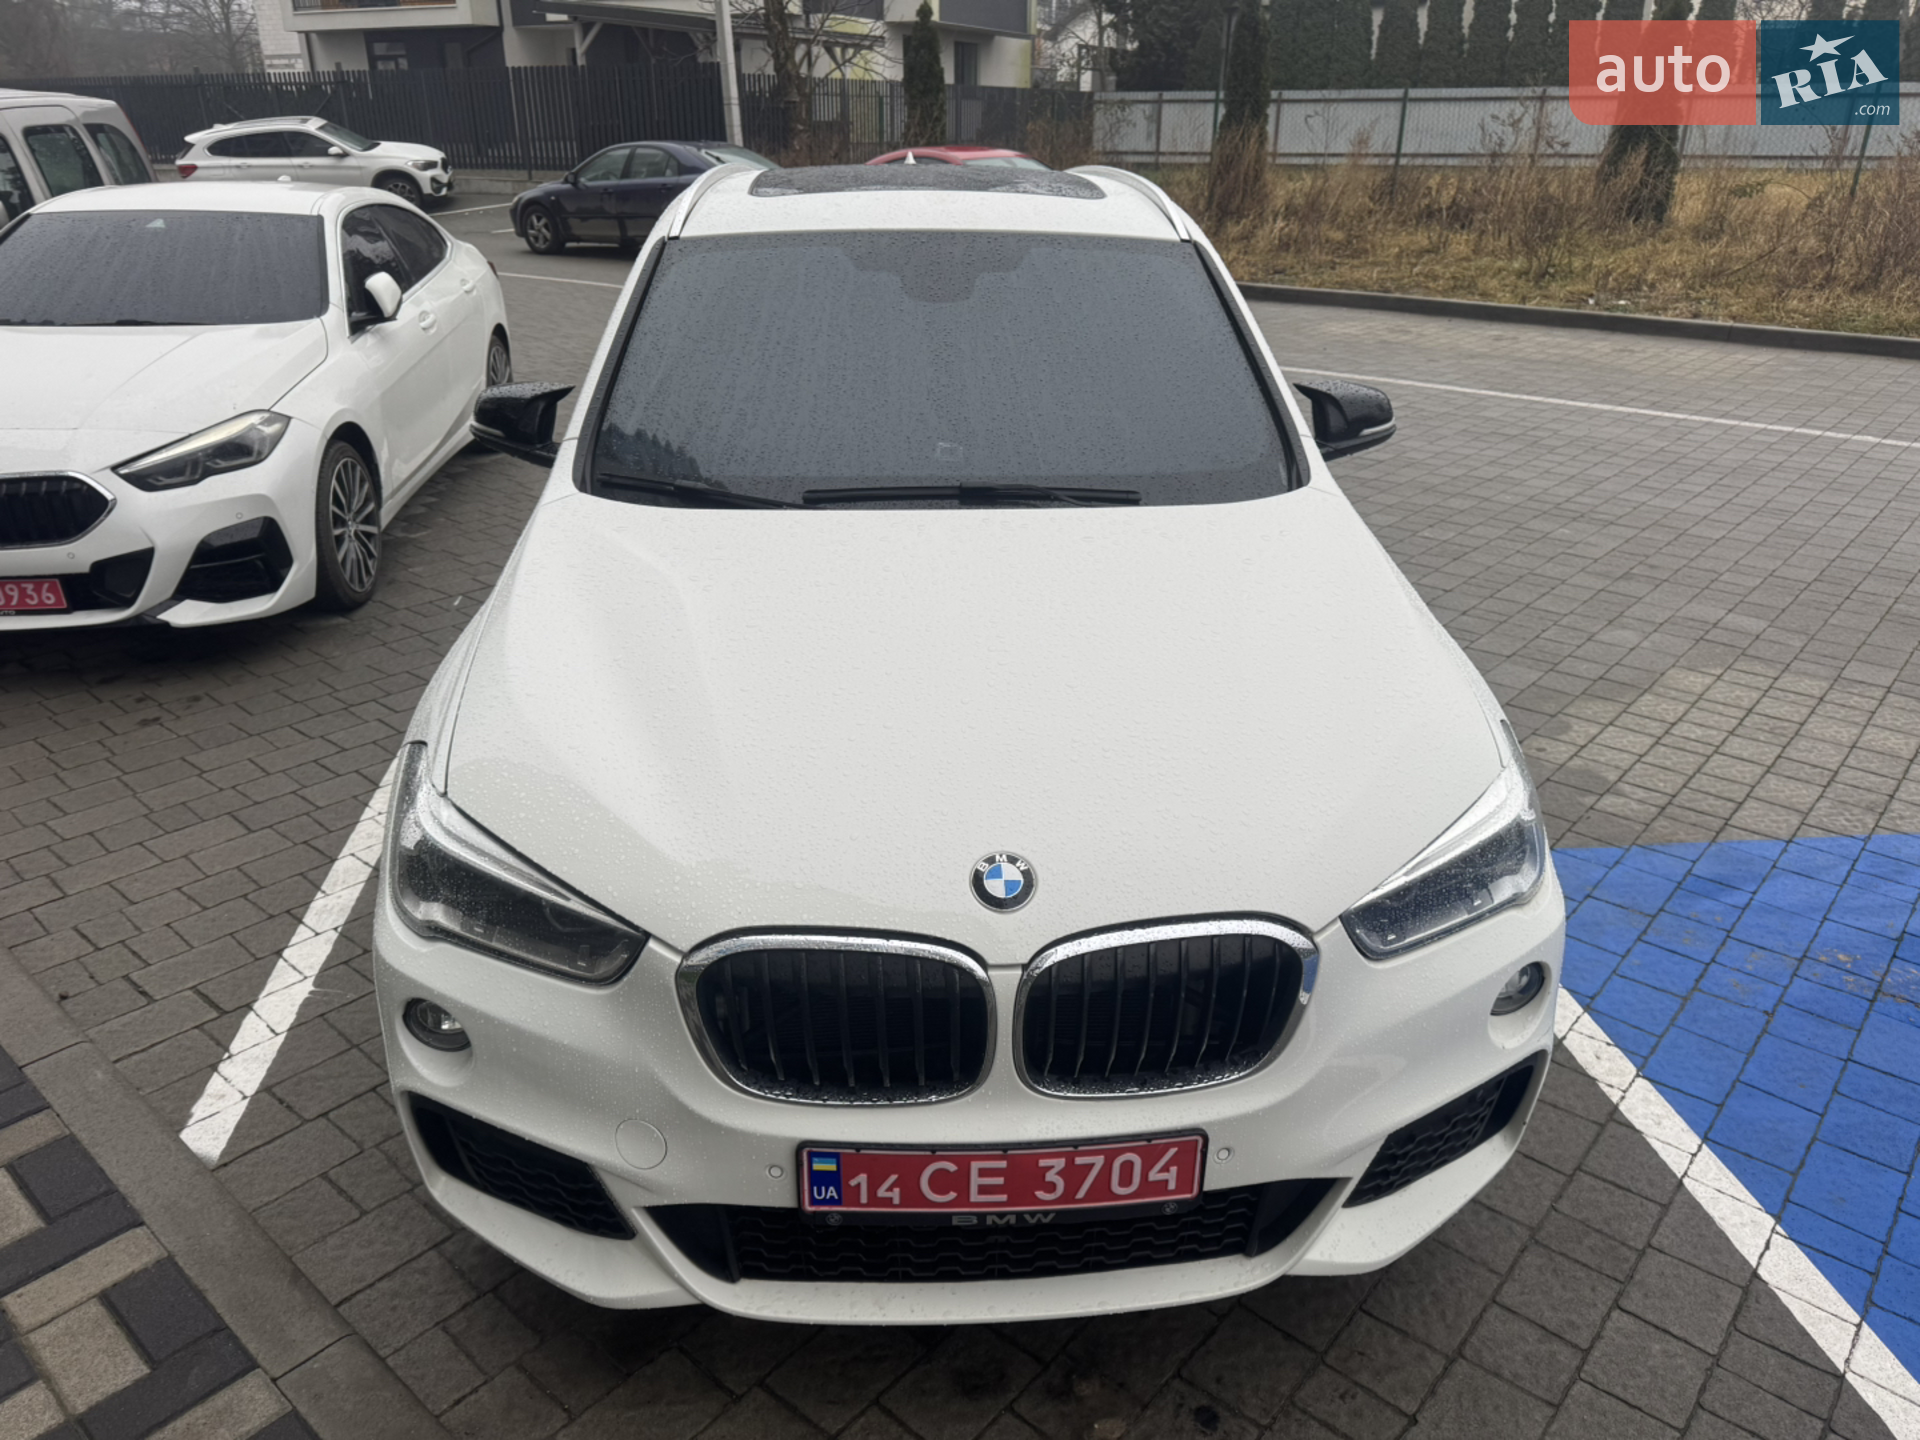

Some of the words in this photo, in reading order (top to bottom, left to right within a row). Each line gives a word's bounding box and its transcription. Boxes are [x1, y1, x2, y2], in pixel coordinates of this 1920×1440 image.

[977, 854, 1028, 872] BMW
[848, 1173, 900, 1204] 14
[919, 1160, 1008, 1203] CE
[1034, 1147, 1179, 1200] 3704
[813, 1186, 838, 1200] UA
[951, 1213, 1056, 1226] BMW
